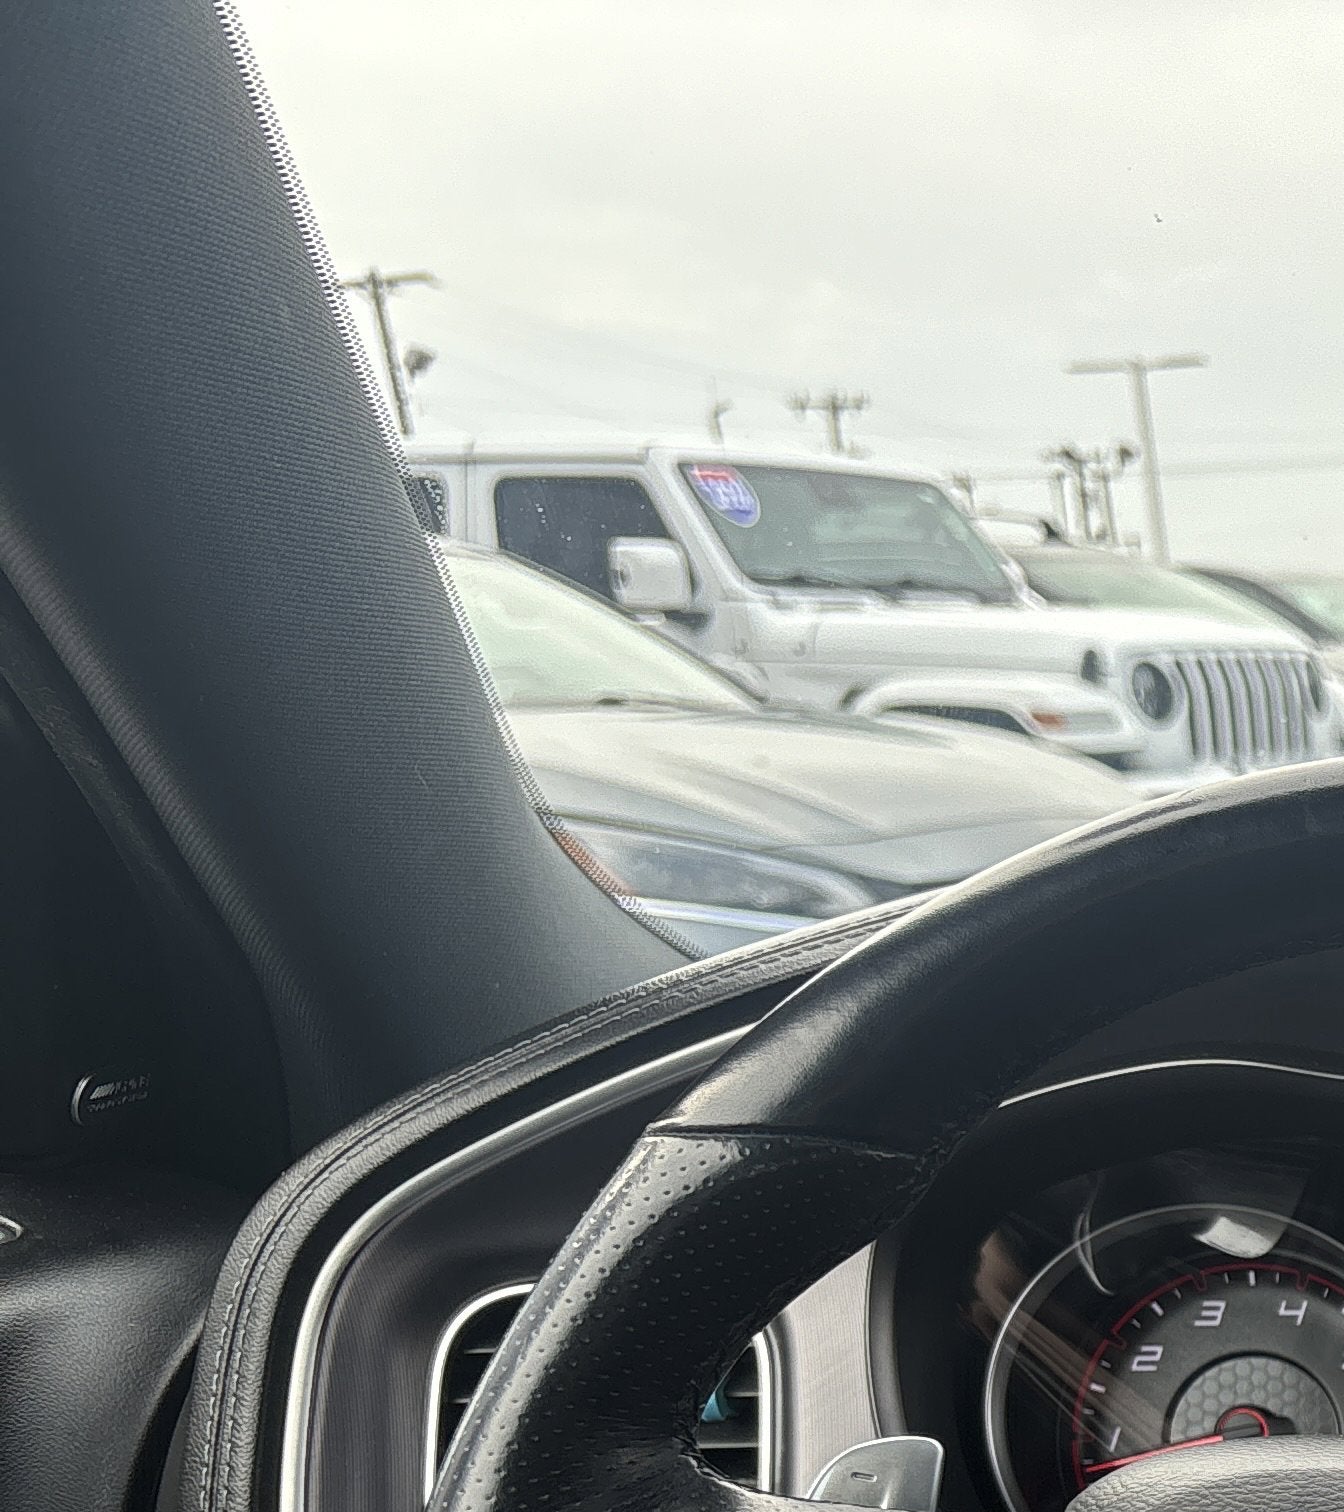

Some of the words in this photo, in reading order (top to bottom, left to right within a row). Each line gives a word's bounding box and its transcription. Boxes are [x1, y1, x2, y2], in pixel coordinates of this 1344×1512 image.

[1194, 1301, 1226, 1327] 3
[1278, 1300, 1308, 1326] 4
[1131, 1345, 1164, 1373] 2
